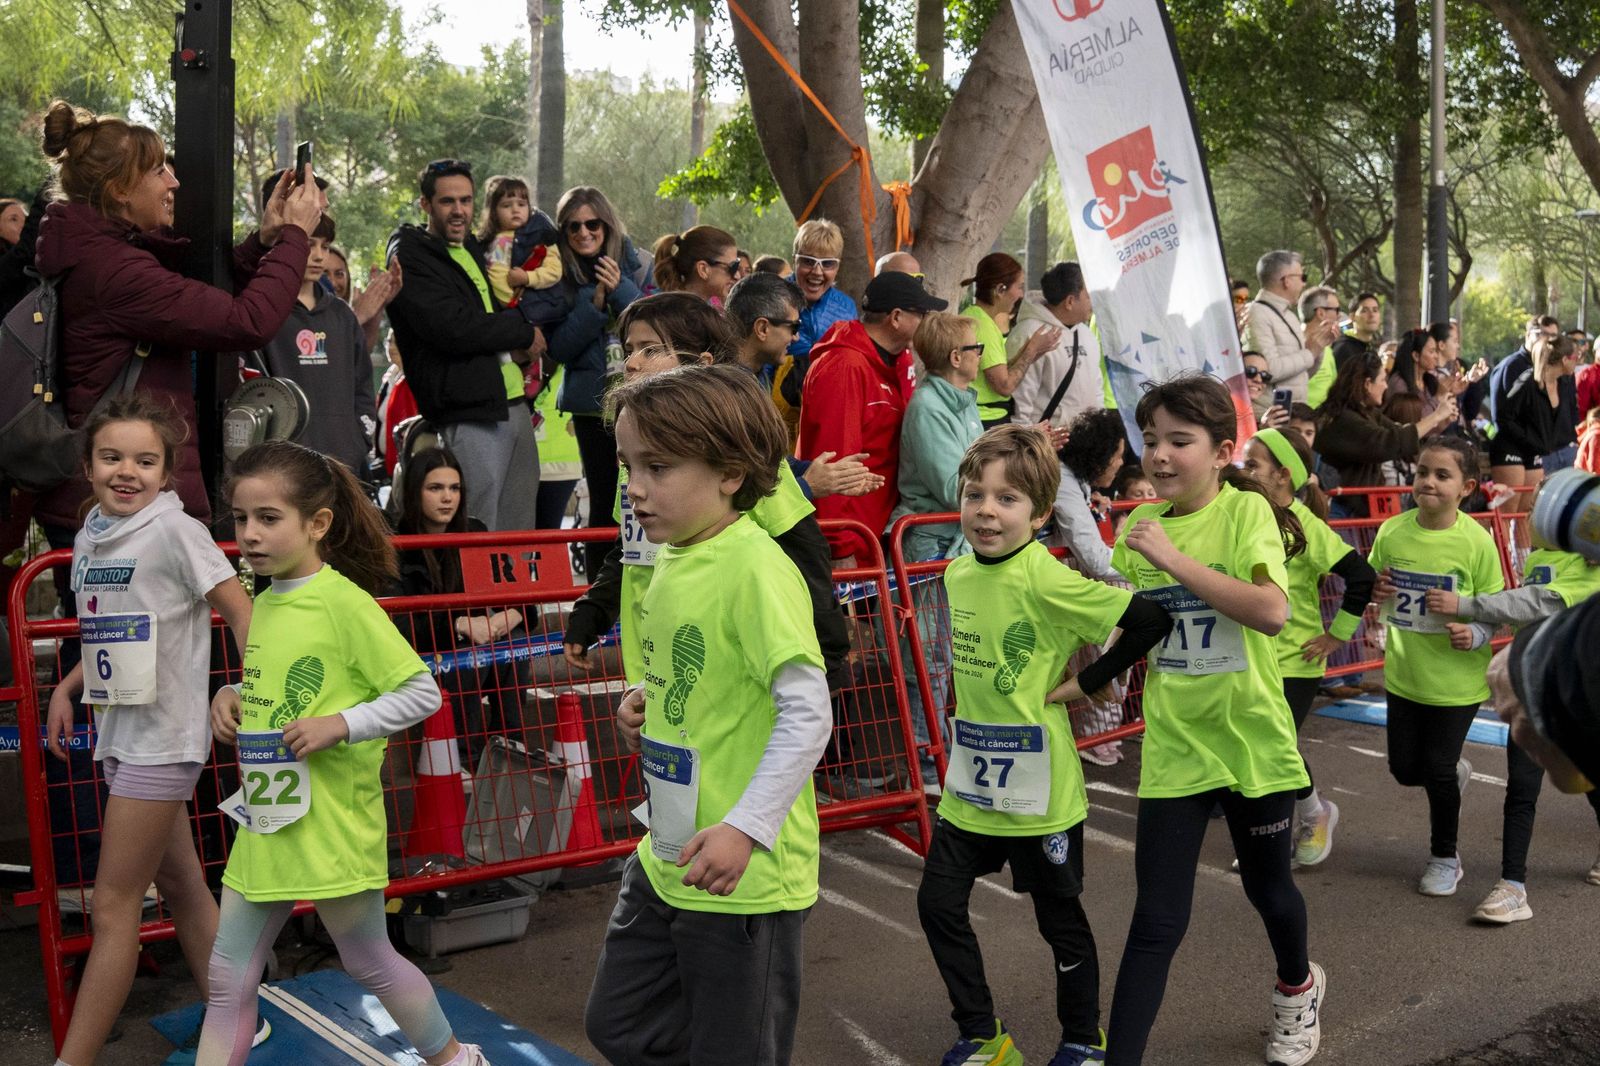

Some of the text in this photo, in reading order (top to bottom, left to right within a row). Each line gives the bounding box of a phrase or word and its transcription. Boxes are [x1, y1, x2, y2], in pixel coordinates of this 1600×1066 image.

[75, 555, 88, 593] 6
[1396, 592, 1426, 616] 21
[99, 631, 124, 640] cáncer
[953, 627, 981, 644] Almería
[96, 649, 112, 681] 6
[969, 656, 997, 669] cáncer
[248, 694, 274, 707] cáncer
[998, 729, 1032, 738] marcha
[979, 739, 986, 748] el
[988, 739, 1019, 749] cáncer
[242, 750, 274, 760] cáncer
[973, 755, 1014, 788] 27
[241, 769, 302, 806] 22
